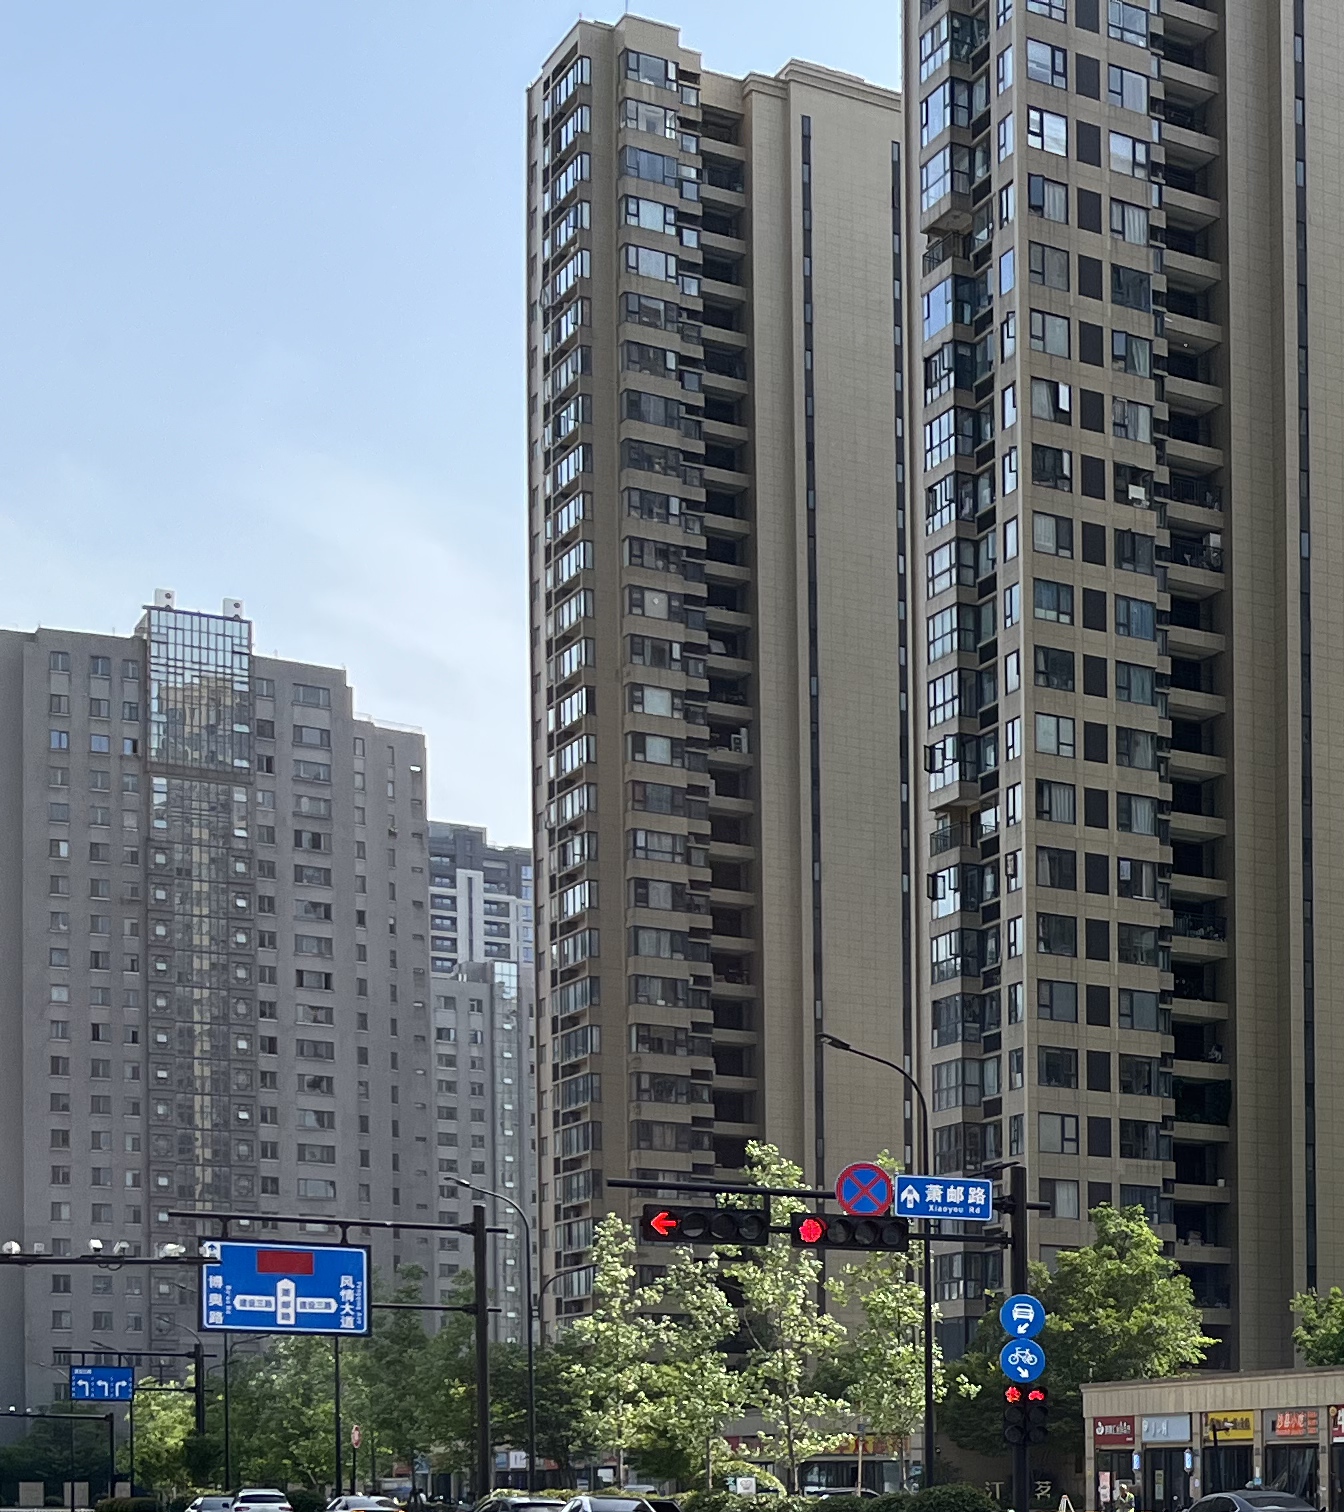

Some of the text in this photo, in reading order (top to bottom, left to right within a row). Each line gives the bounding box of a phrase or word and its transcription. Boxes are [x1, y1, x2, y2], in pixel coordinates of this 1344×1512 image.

[925, 1184, 986, 1205] 萧邮路
[928, 1204, 981, 1214] Xiaoyou Rd
[339, 1275, 355, 1329] 风情大道
